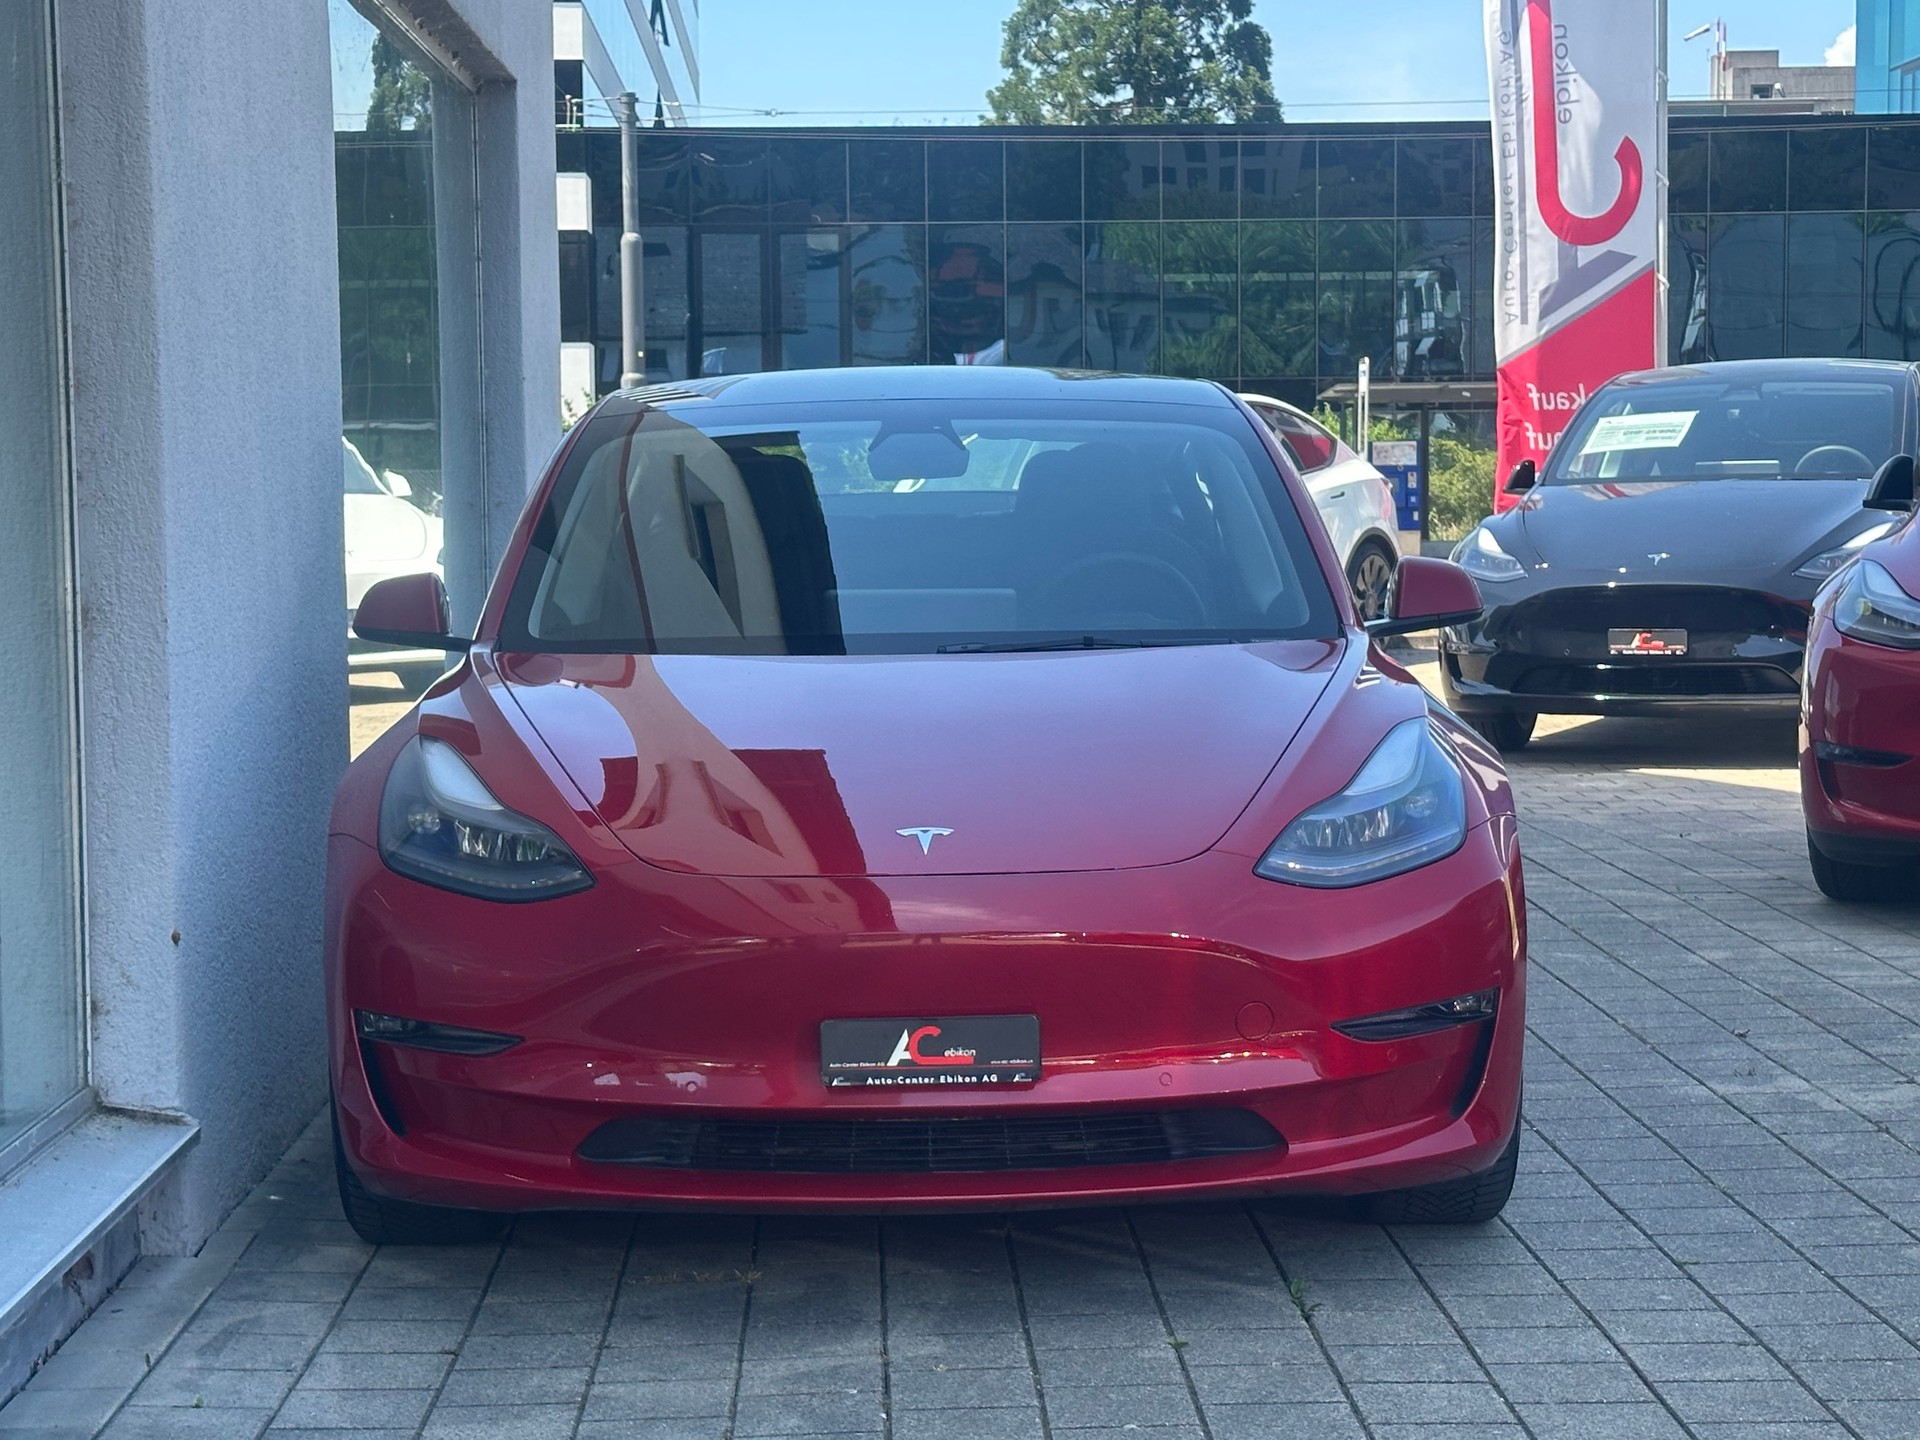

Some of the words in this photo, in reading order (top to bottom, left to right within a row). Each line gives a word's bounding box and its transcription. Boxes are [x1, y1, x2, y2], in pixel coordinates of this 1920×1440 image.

[943, 1046, 977, 1058] ebikon
[866, 1076, 935, 1086] Auto-Center
[939, 1074, 978, 1084] Ebikon
[981, 1073, 999, 1083] AG
